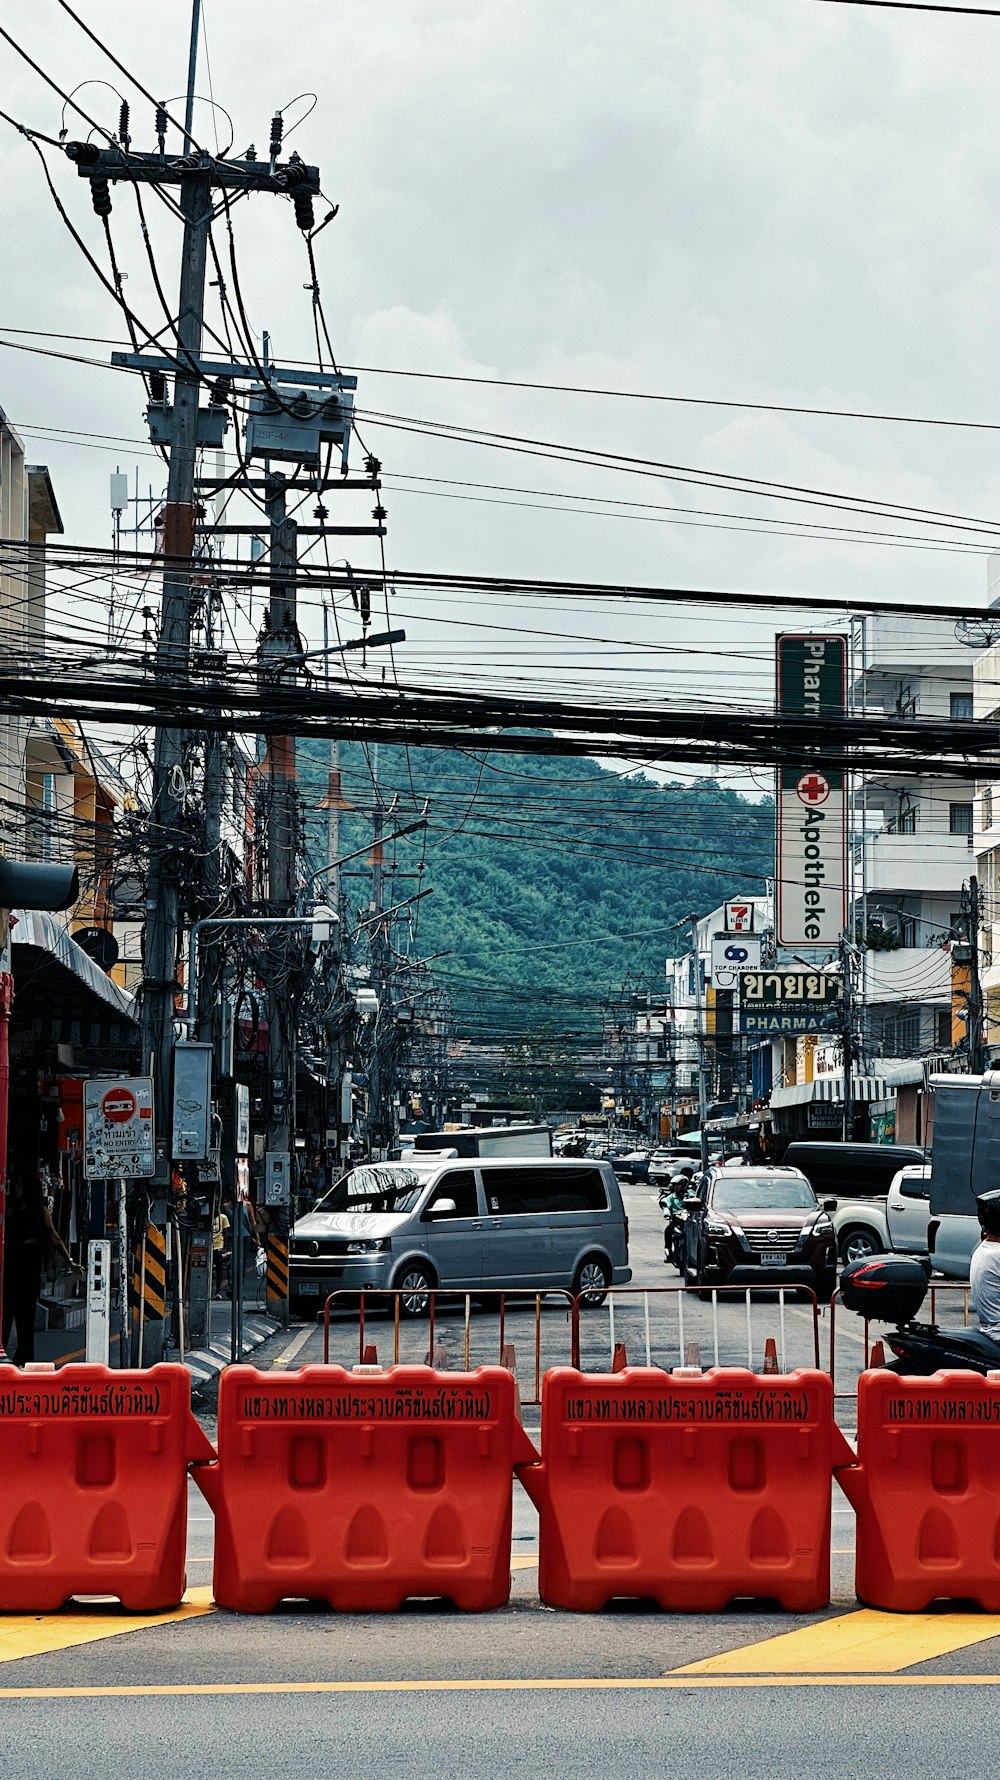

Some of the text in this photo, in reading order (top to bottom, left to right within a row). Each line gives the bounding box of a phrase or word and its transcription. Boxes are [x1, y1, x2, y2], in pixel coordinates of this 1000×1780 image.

[800, 806, 825, 939] Apotheke
[731, 906, 748, 930] 7
[115, 1139, 136, 1147] ENTRY
[123, 1164, 142, 1174] AIS
